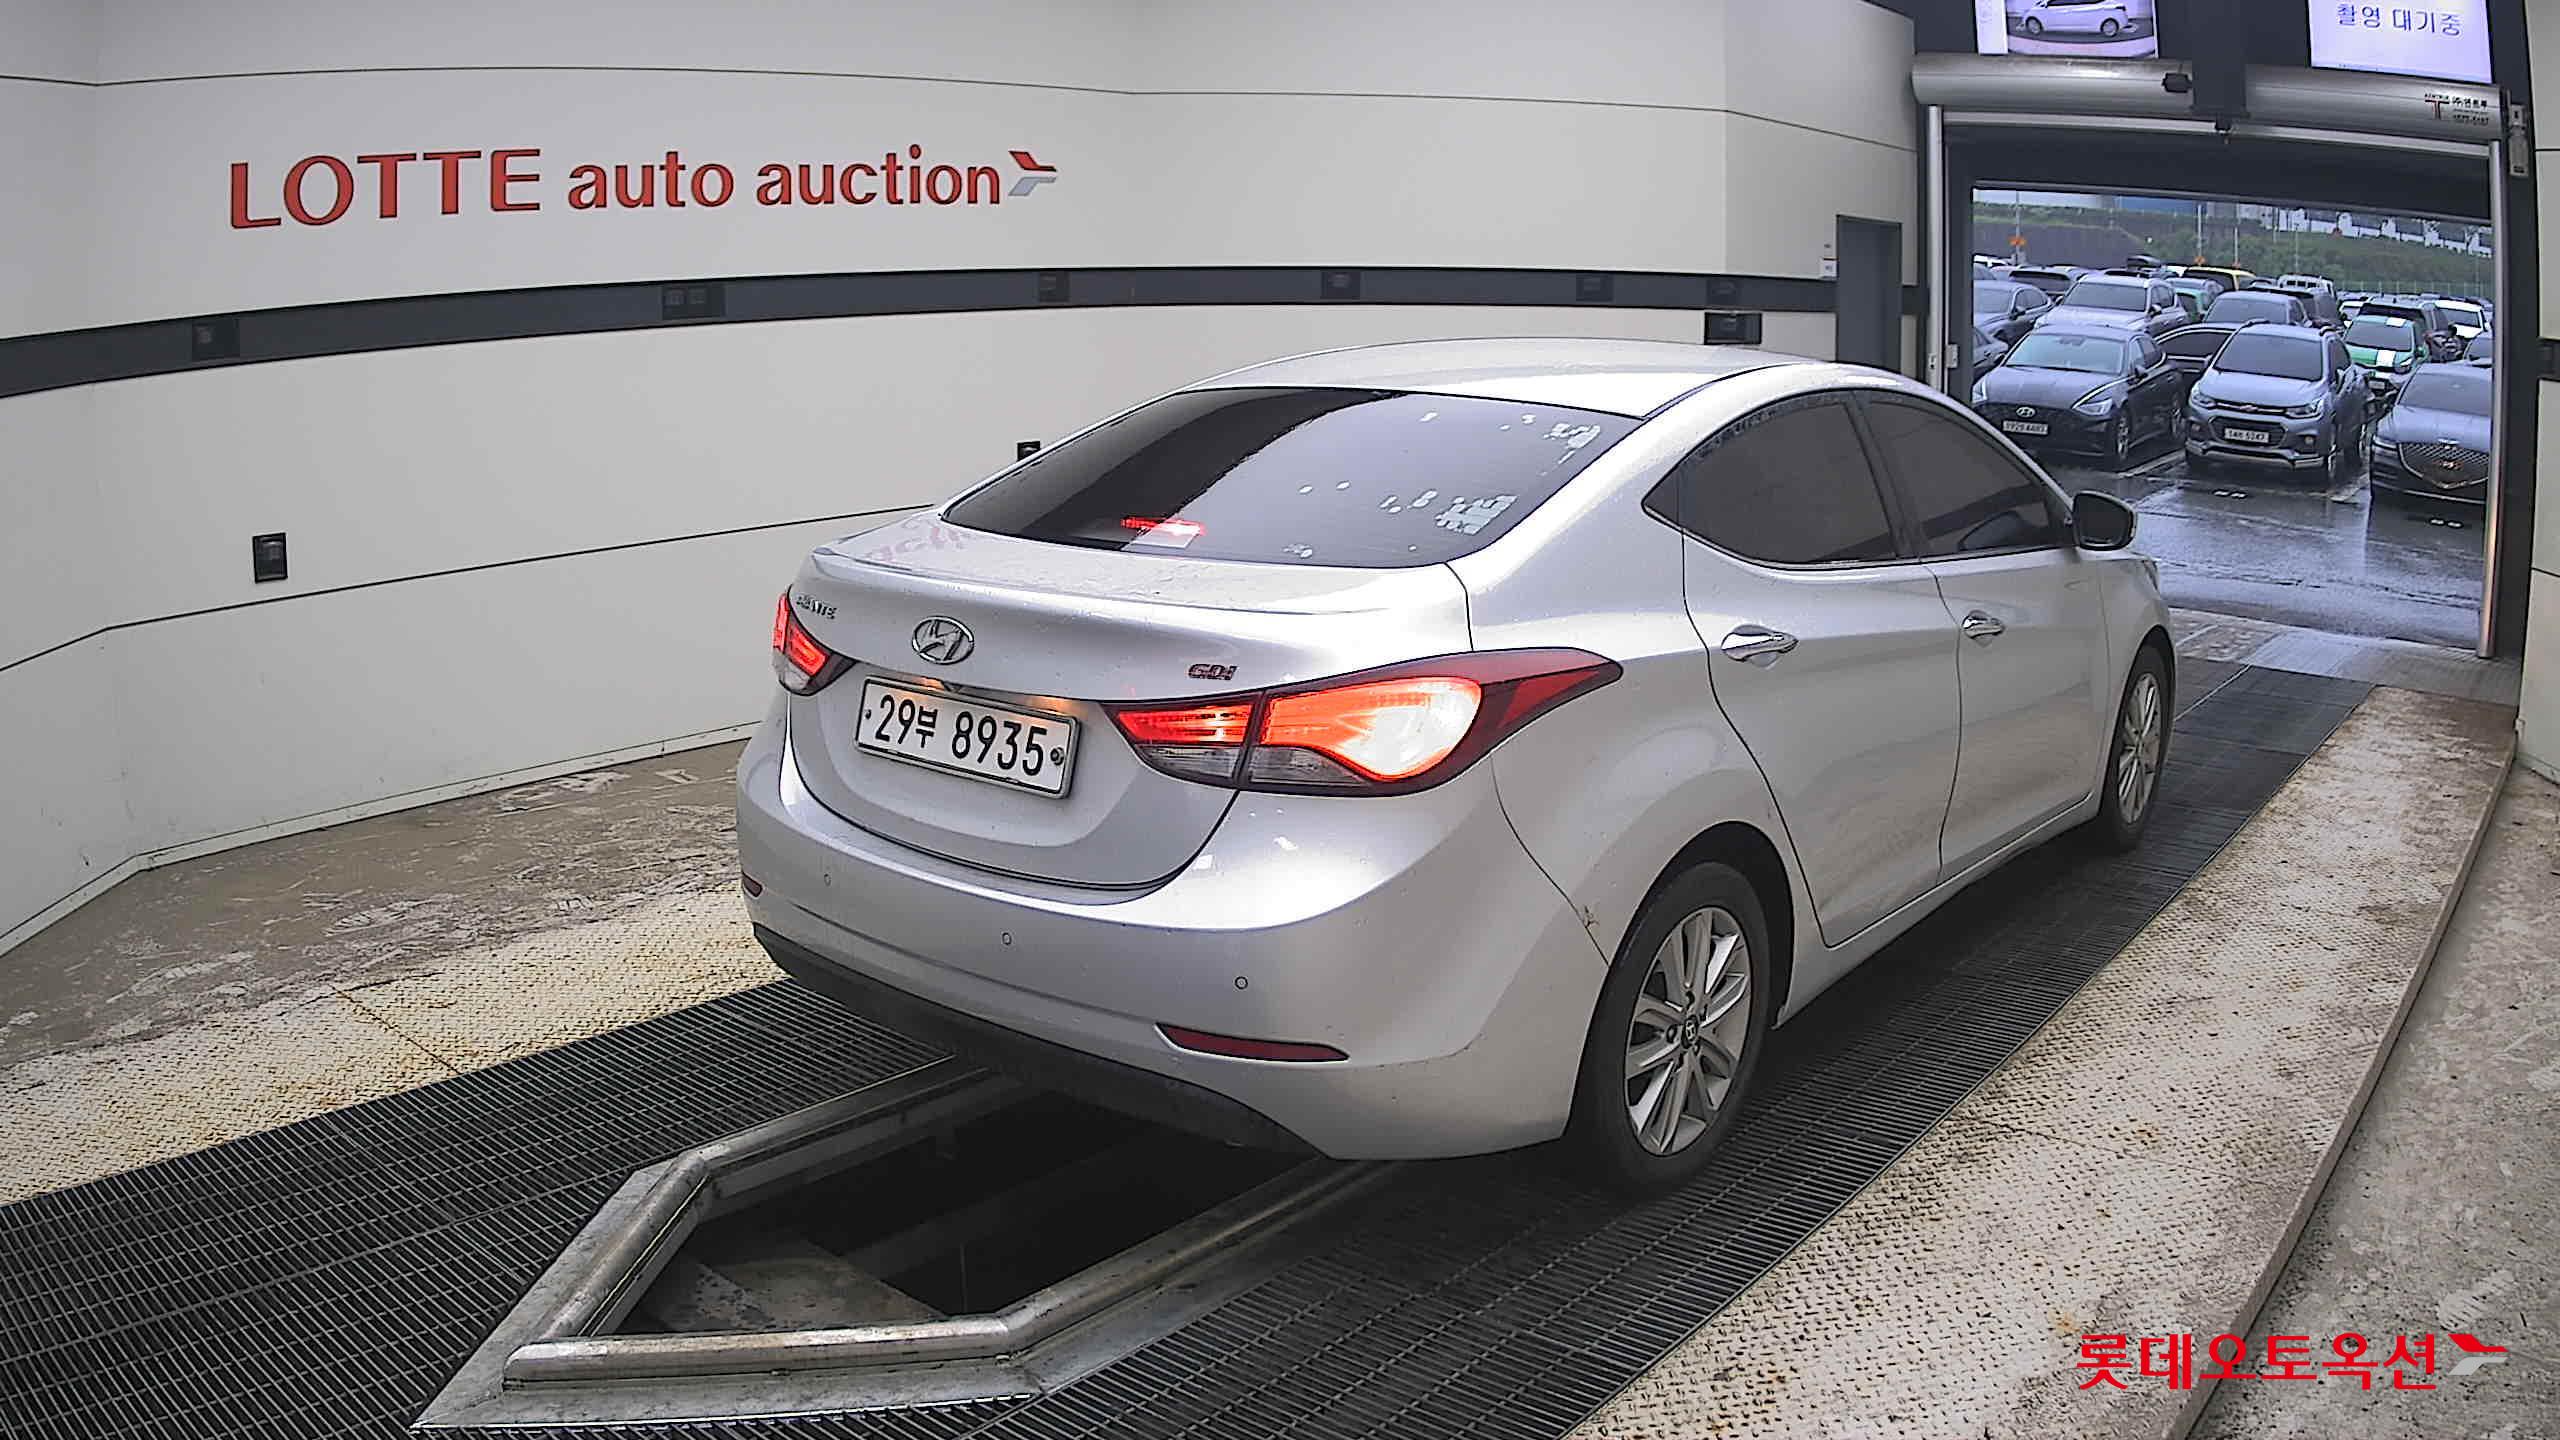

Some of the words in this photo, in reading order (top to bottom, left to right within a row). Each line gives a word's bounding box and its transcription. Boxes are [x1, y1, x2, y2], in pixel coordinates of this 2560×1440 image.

[2337, 3, 2380, 28] 촬영
[2392, 8, 2461, 36] 대기중
[230, 148, 541, 230] LOTTE
[568, 151, 734, 209] auto
[756, 144, 1000, 206] auction
[875, 694, 938, 748] 29부
[952, 711, 1047, 776] 8935
